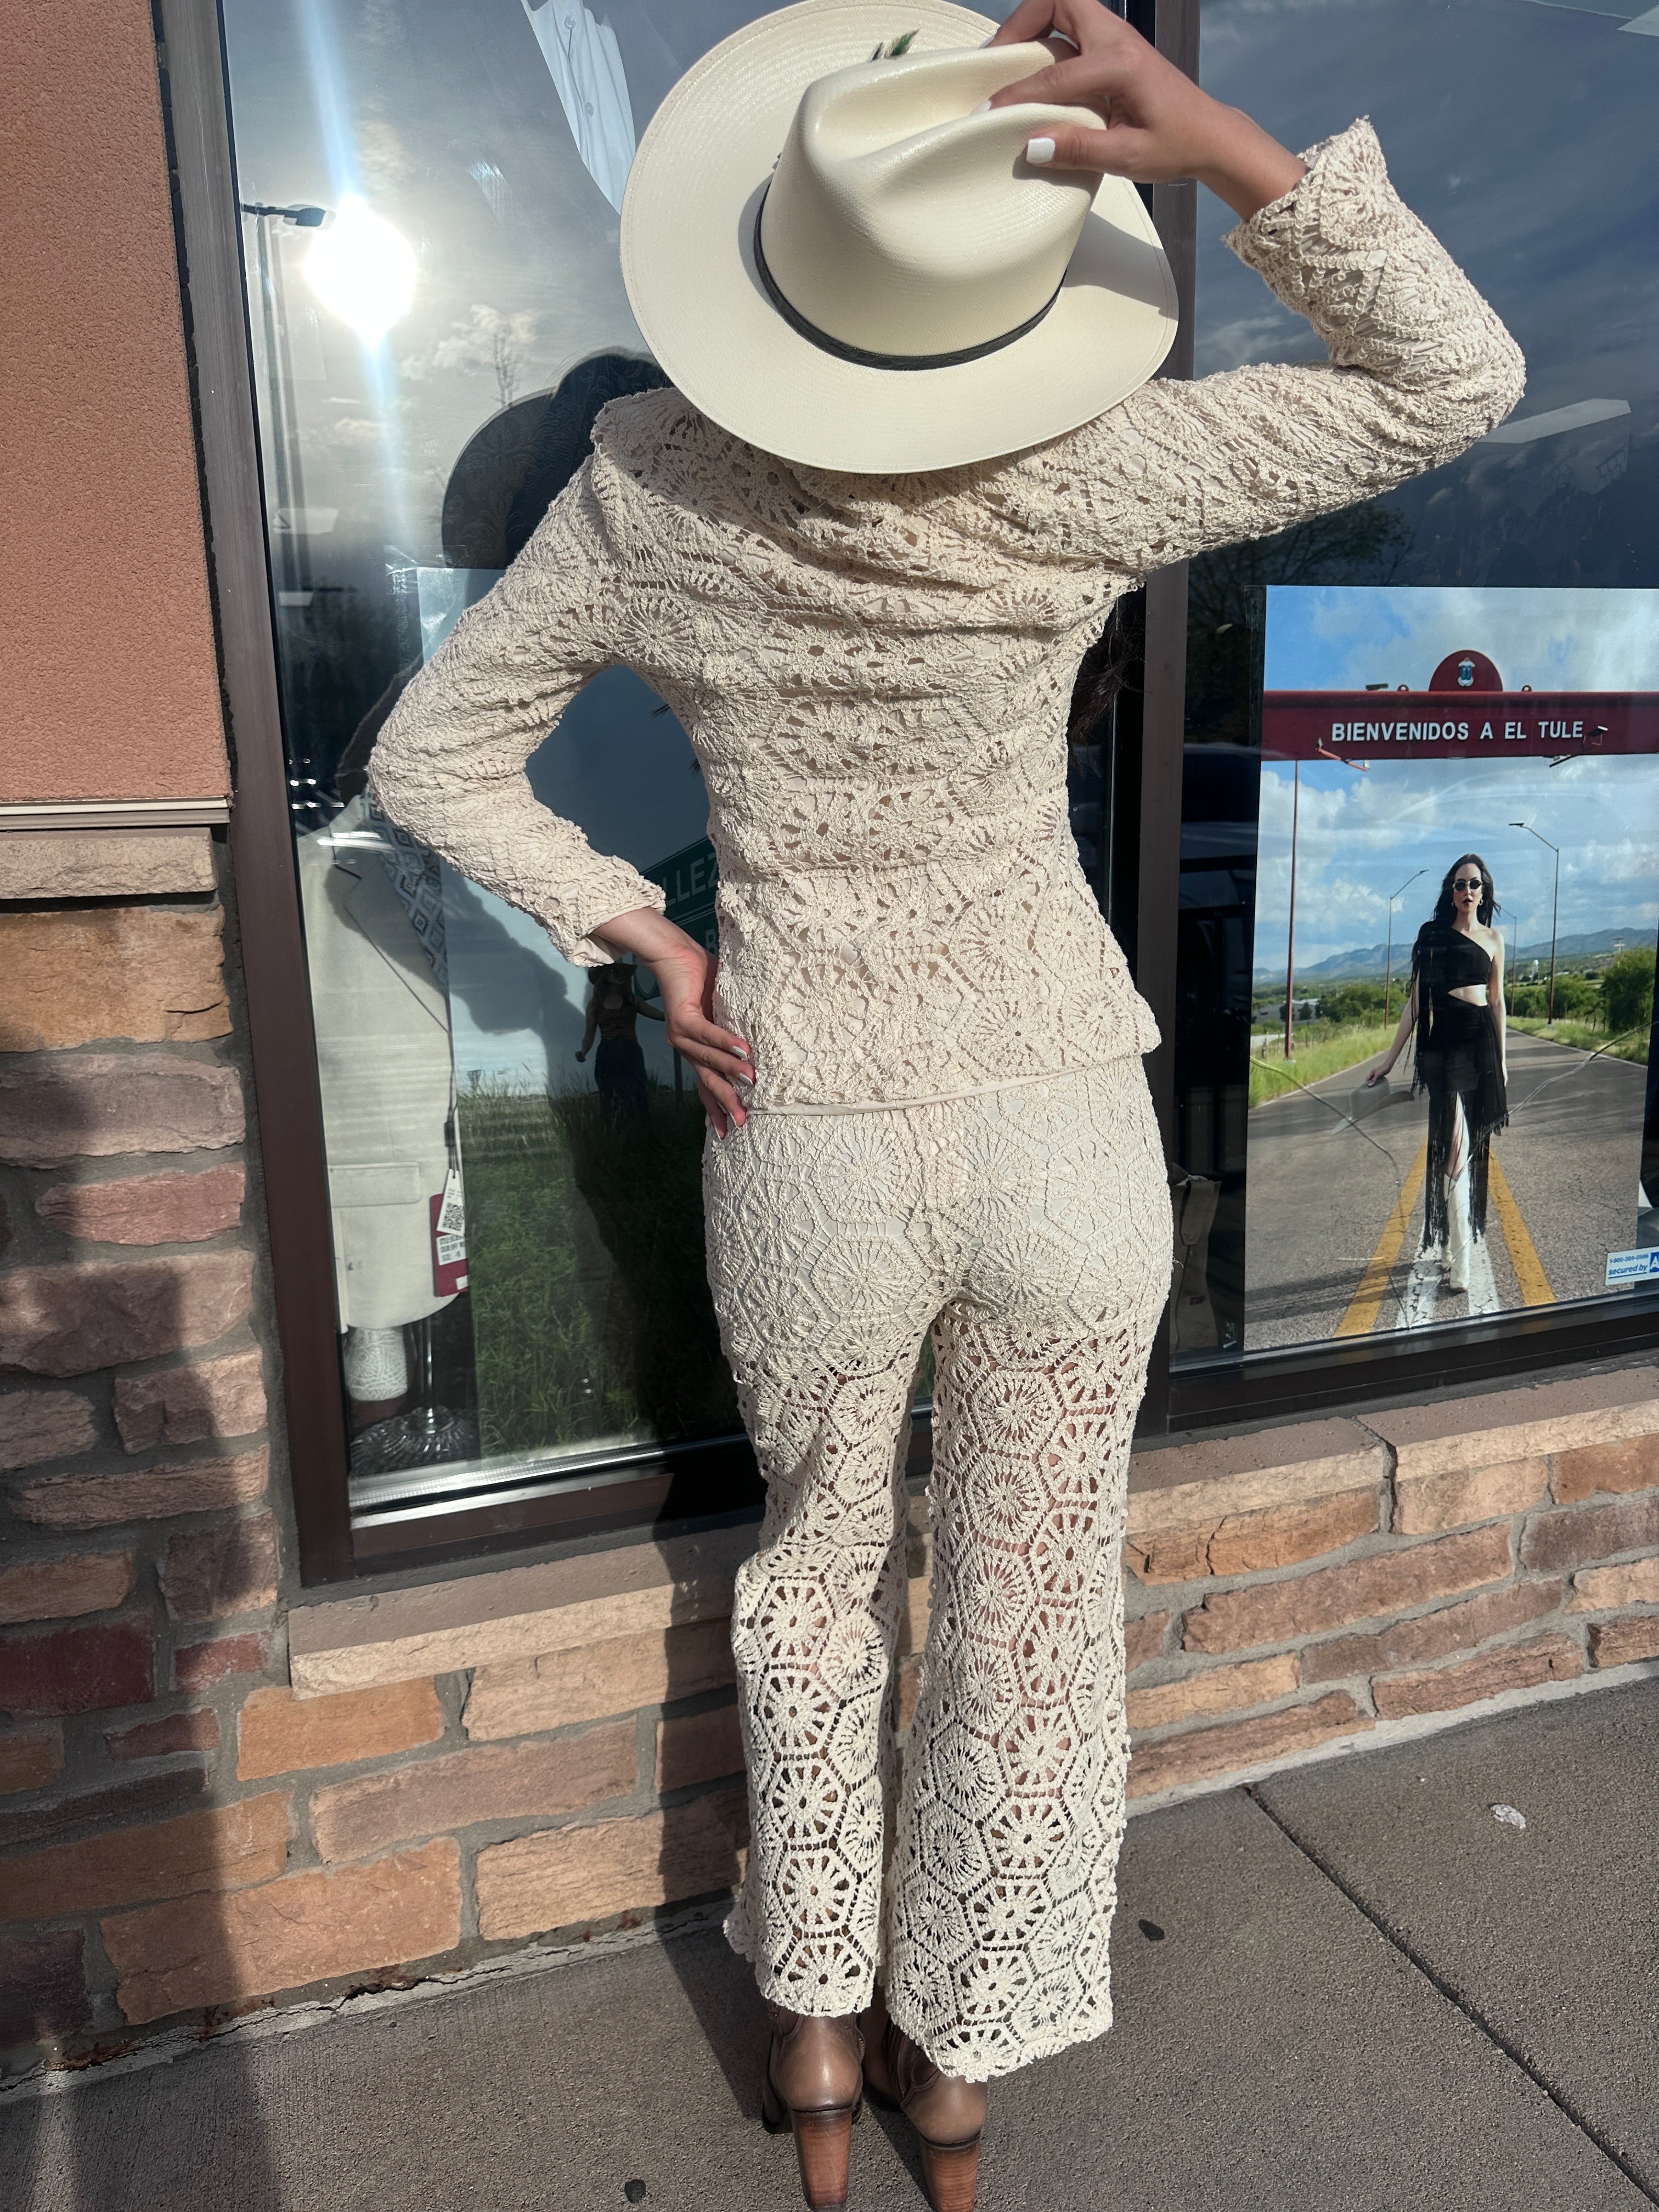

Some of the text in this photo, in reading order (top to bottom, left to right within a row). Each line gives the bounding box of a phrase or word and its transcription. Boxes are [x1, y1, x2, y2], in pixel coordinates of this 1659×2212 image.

[1332, 721, 1584, 742] BIENVENIDOS A EL TULE
[1609, 1264, 1638, 1275] secured
